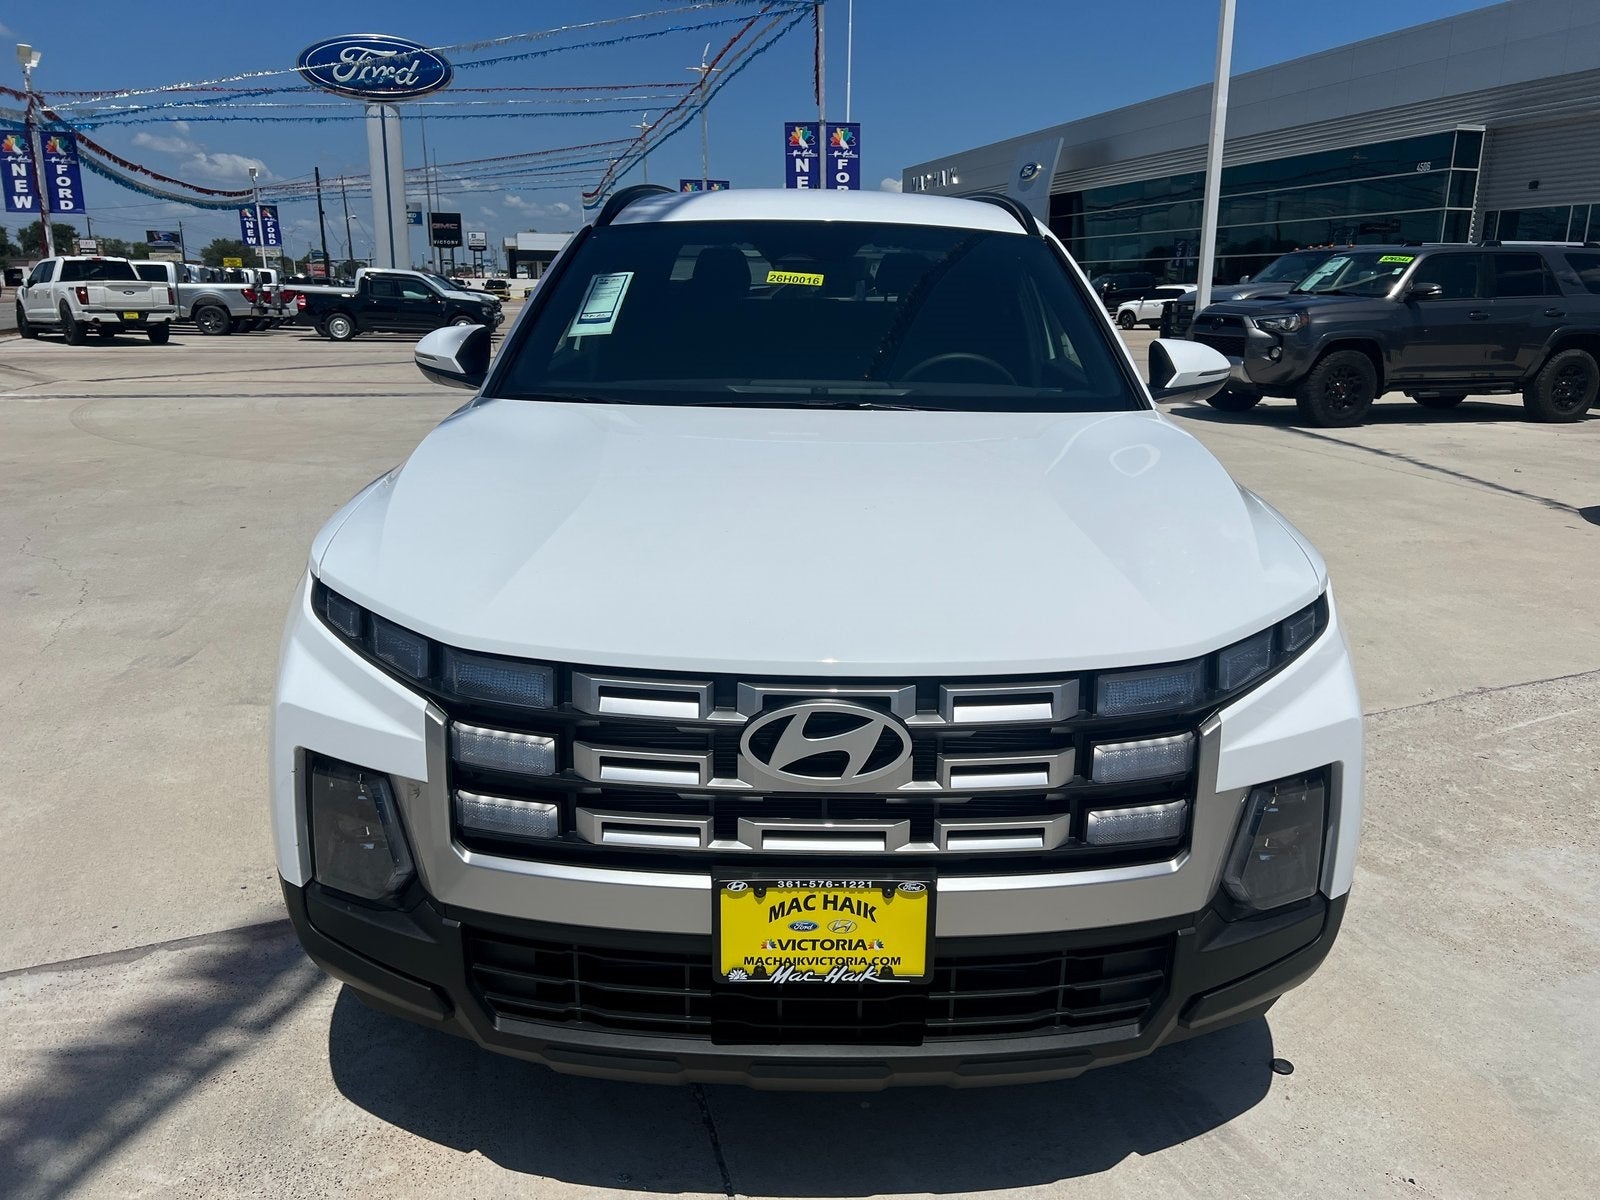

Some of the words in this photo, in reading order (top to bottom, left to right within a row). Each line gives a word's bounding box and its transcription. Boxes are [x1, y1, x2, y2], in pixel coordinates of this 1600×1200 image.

[332, 46, 420, 85] Ford
[11, 163, 32, 209] NEW
[56, 164, 74, 210] FORD
[911, 174, 932, 192] MAC
[933, 167, 959, 188] HAIK
[245, 221, 257, 245] NEW
[267, 221, 277, 245] FORD
[432, 222, 458, 230] GMC
[768, 273, 821, 285] 26H0016
[777, 880, 874, 889] 361-576-1221
[769, 895, 816, 923] MAC
[822, 894, 878, 923] HAIK
[793, 921, 814, 931] Ford
[776, 938, 869, 951] VICTORIA
[743, 956, 901, 966] MACHAIKVICTORIA.COM
[768, 965, 822, 984] Mac
[824, 965, 881, 984] Haik
